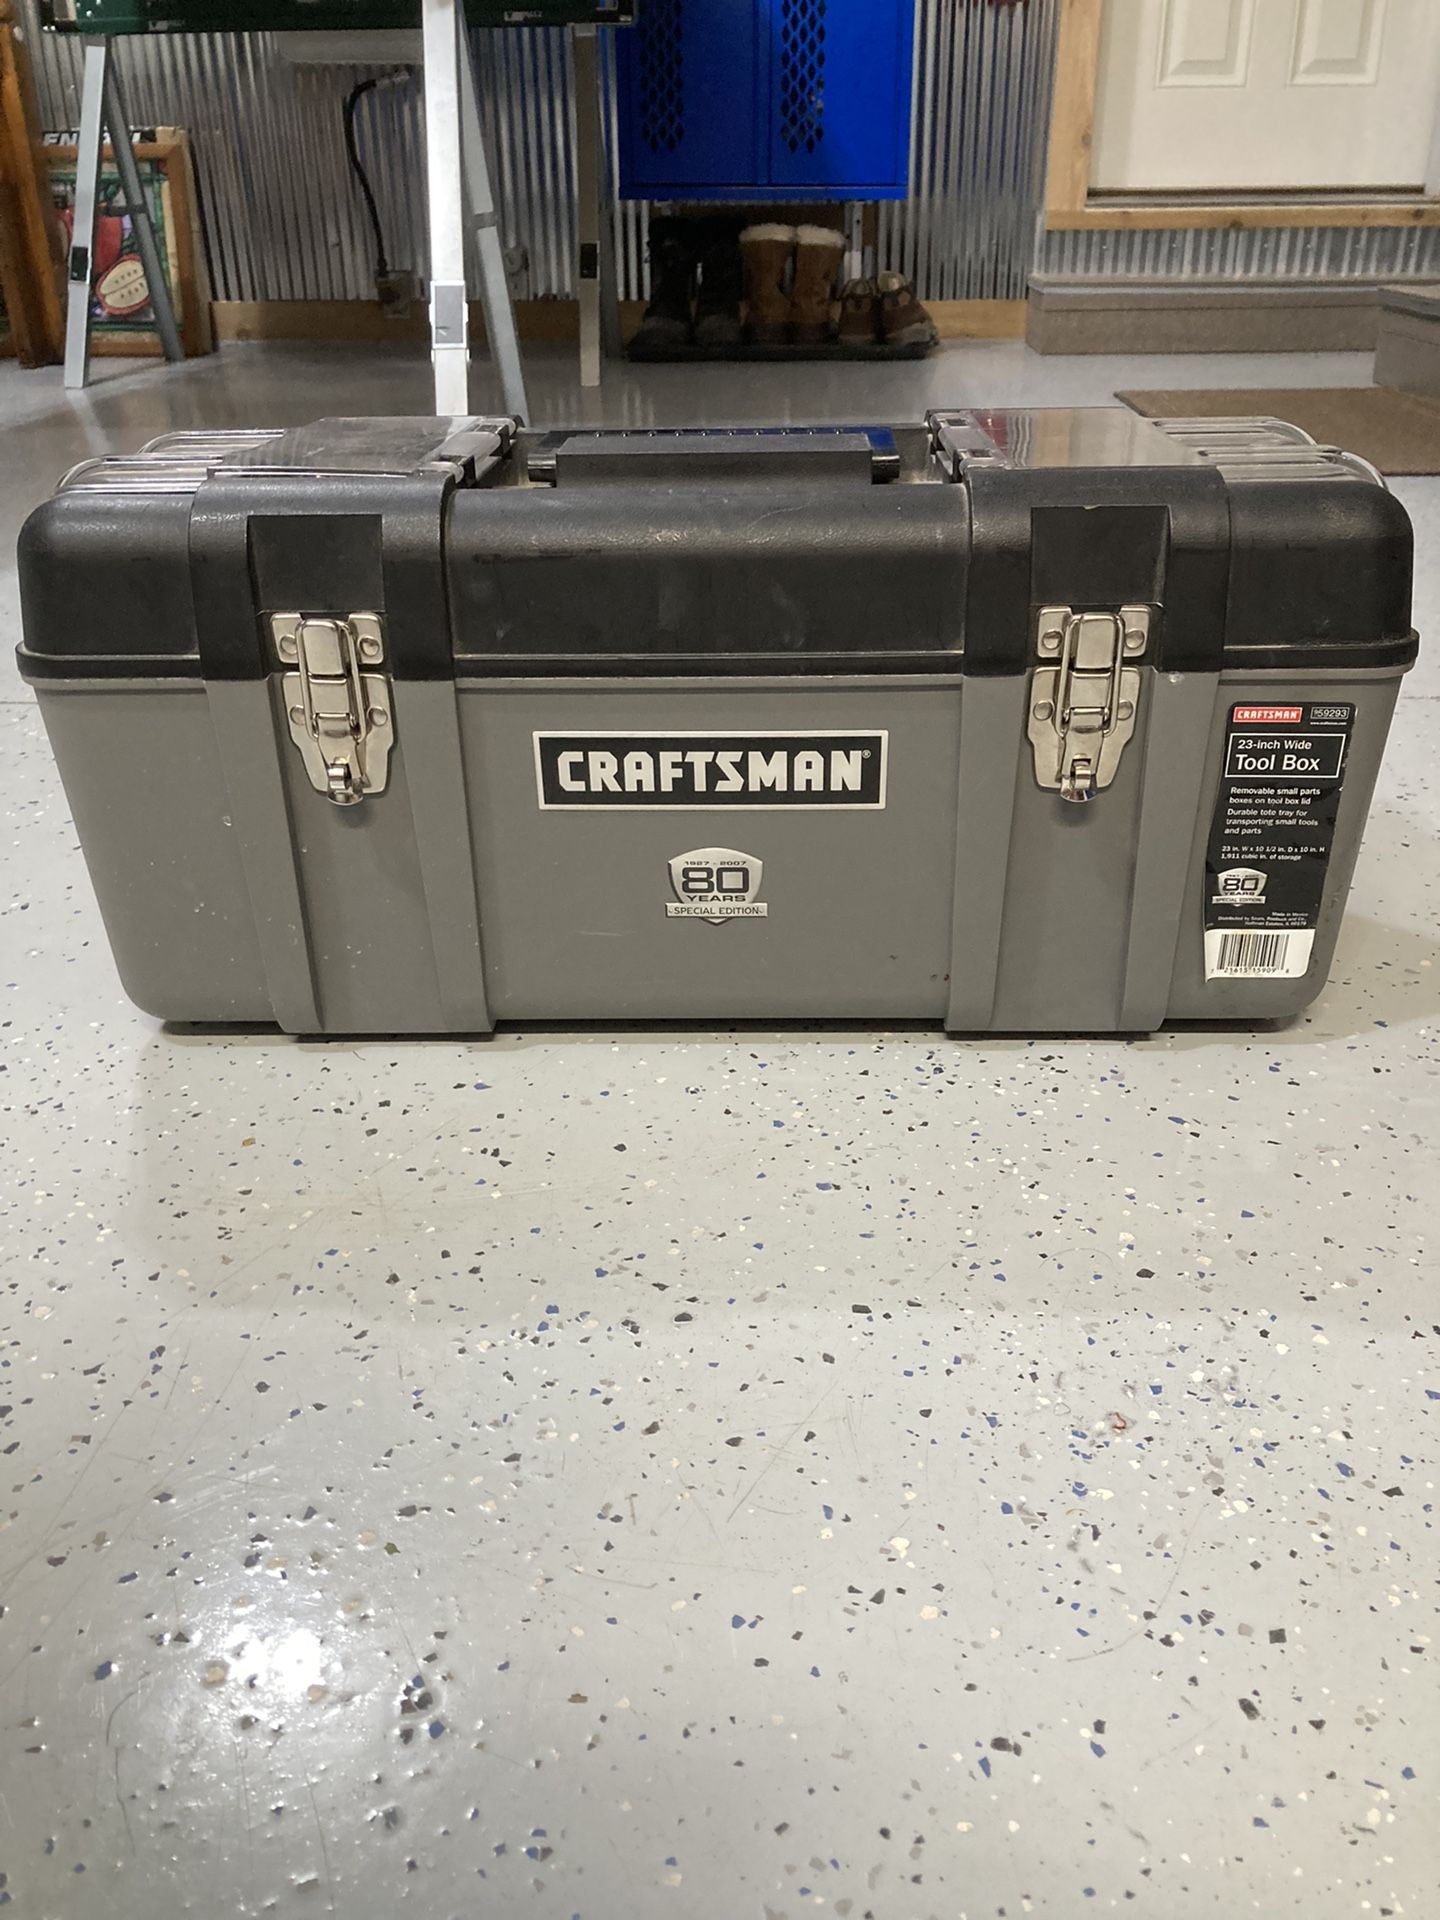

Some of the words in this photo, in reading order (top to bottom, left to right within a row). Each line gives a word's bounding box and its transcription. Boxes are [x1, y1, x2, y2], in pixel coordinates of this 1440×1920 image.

[1237, 710, 1298, 719] CRAFTSMAN
[1238, 739, 1281, 750] 23-inch
[1284, 740, 1312, 750] Wide
[1235, 754, 1276, 771] Tool
[1282, 754, 1320, 771] Box
[1230, 786, 1275, 795] Removable
[1277, 787, 1299, 795] small
[1300, 788, 1321, 796] parts
[1301, 797, 1311, 805] lid
[1227, 808, 1258, 816] Durable
[1278, 809, 1294, 817] tray
[1226, 818, 1274, 827] transporting
[1275, 818, 1297, 826] small
[682, 867, 749, 893] 80
[1222, 877, 1259, 891] 80
[674, 907, 715, 915] SPECIAL
[718, 907, 759, 915] EDITION
